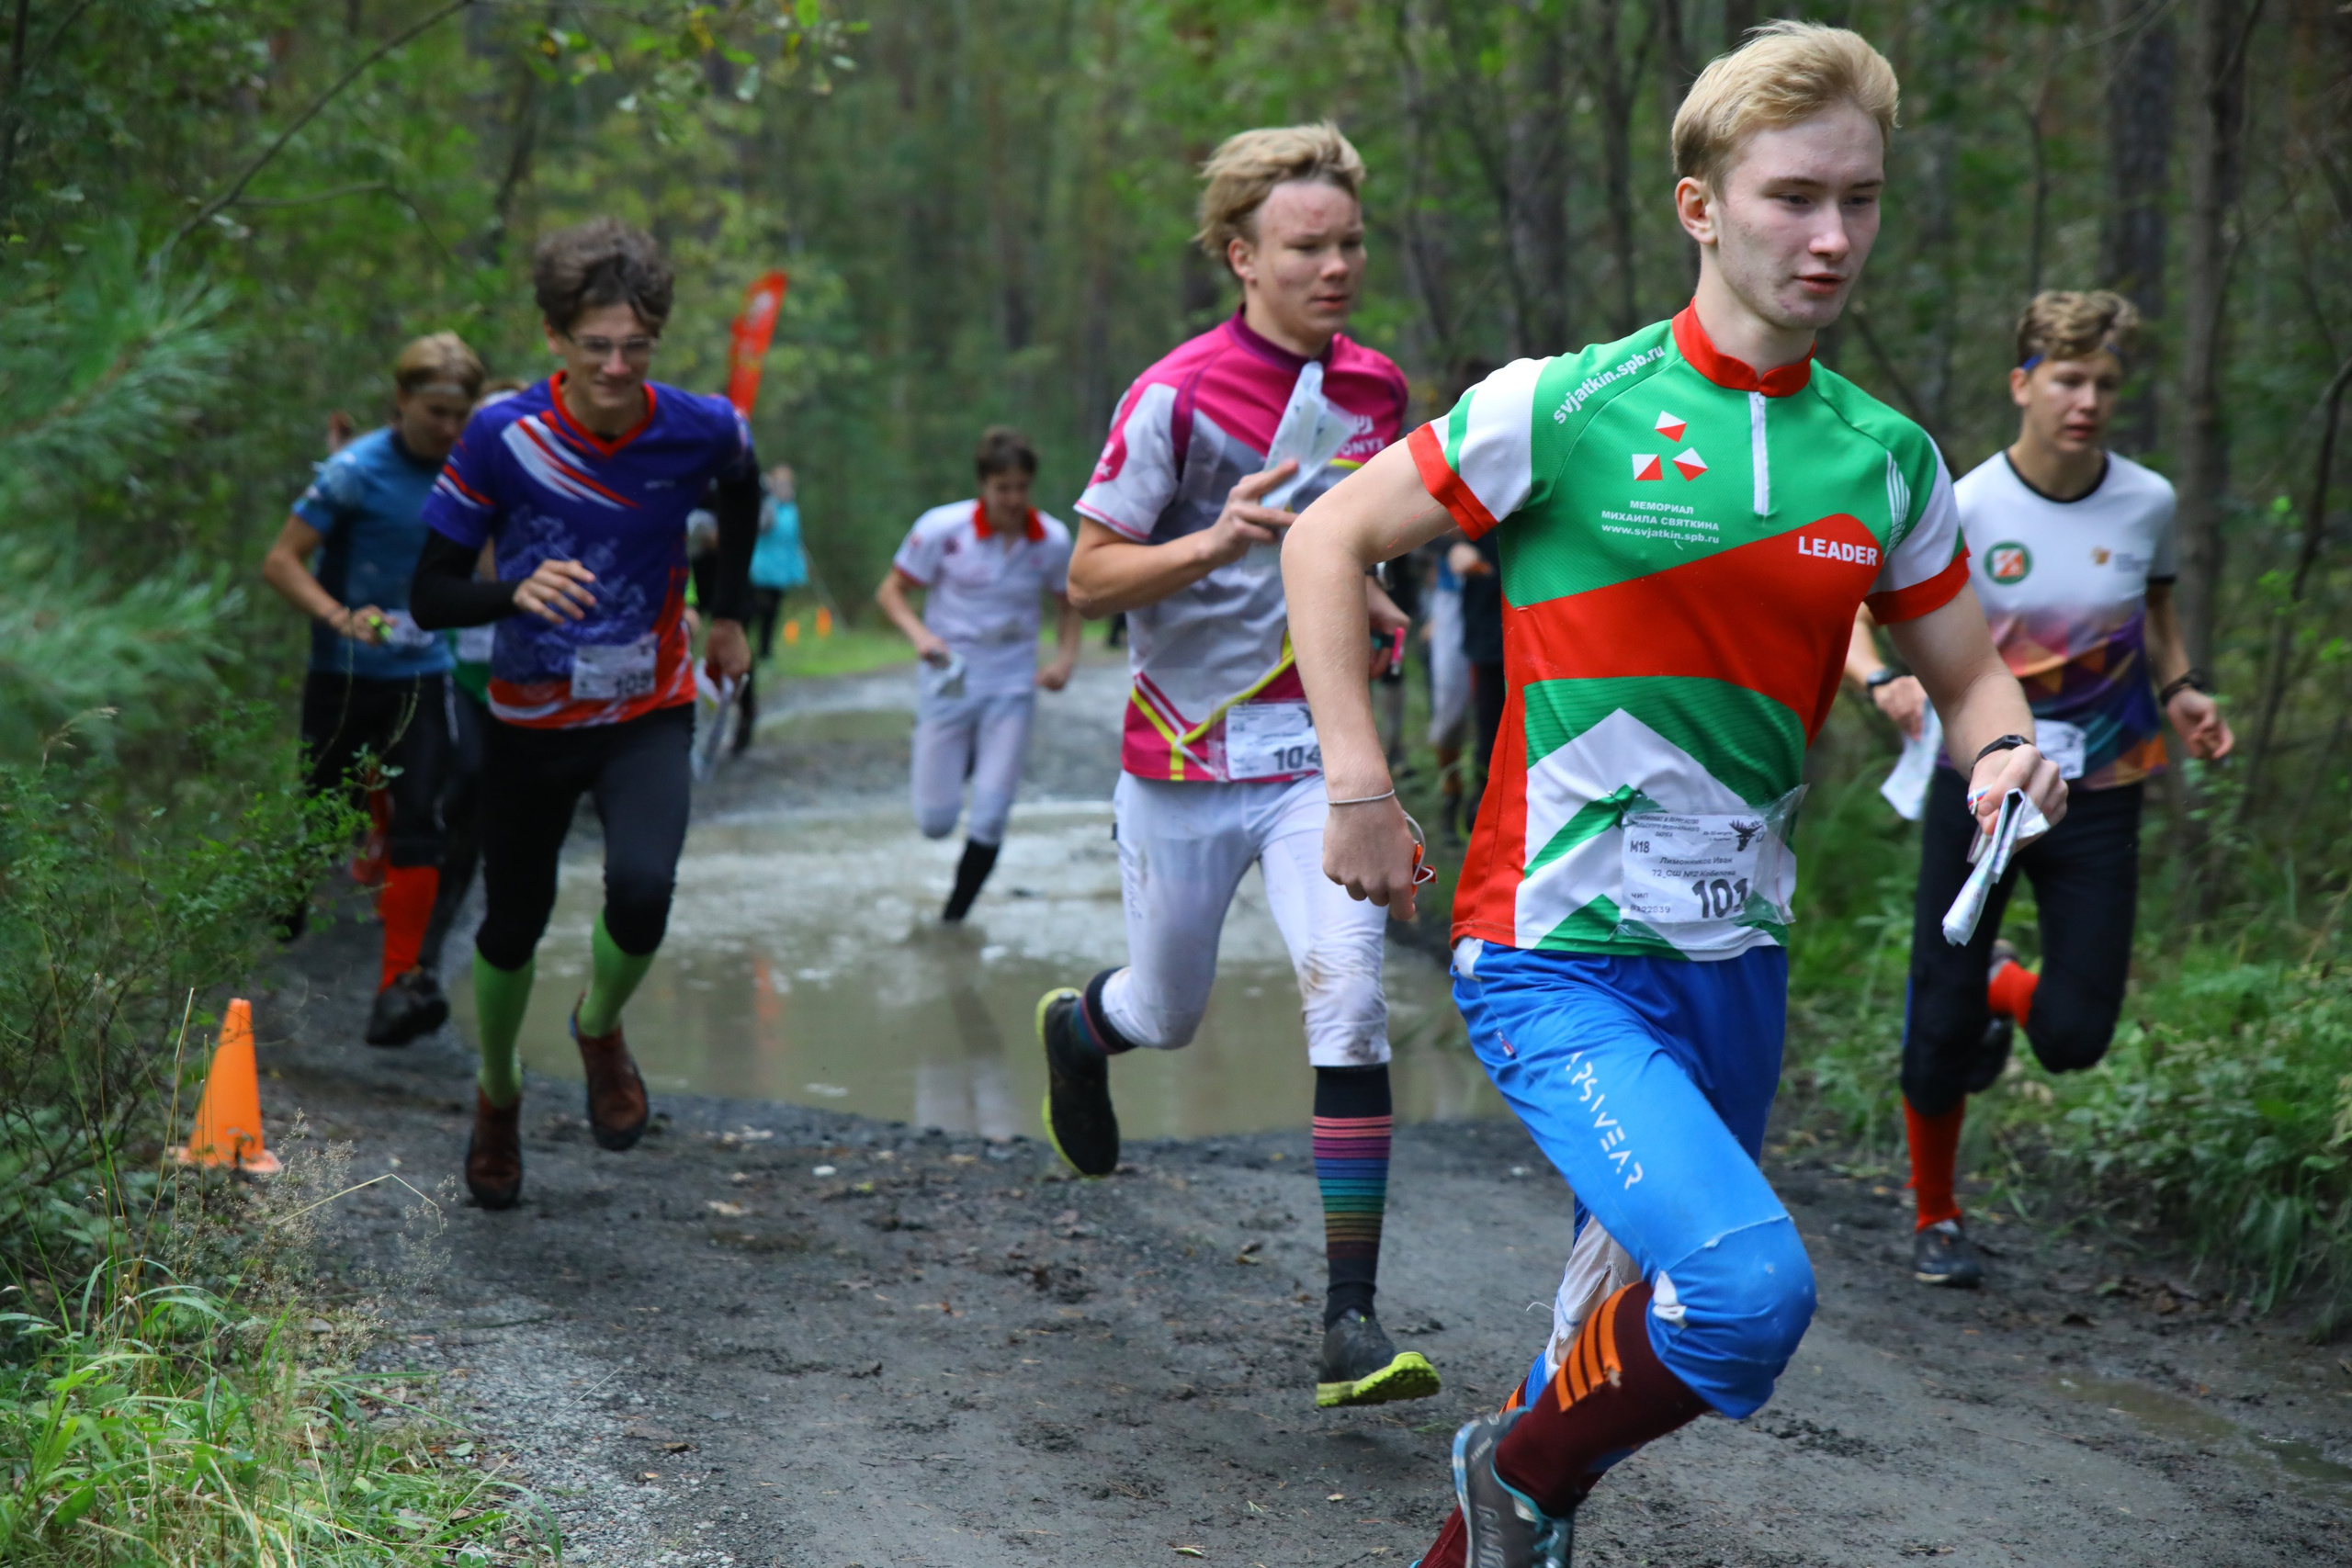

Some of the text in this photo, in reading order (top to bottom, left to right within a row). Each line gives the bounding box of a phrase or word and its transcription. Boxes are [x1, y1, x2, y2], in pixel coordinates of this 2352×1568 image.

[1554, 345, 1666, 424] svjatkin.spb.ru
[1629, 500, 1694, 514] МЕМОРИАЛ
[1601, 510, 1720, 531] МИХАИЛА СВЯТКИНА
[1601, 525, 1720, 544] www.svjatkin.spb.ru
[1798, 536, 1878, 567] LEADER
[1691, 878, 1747, 919] 101
